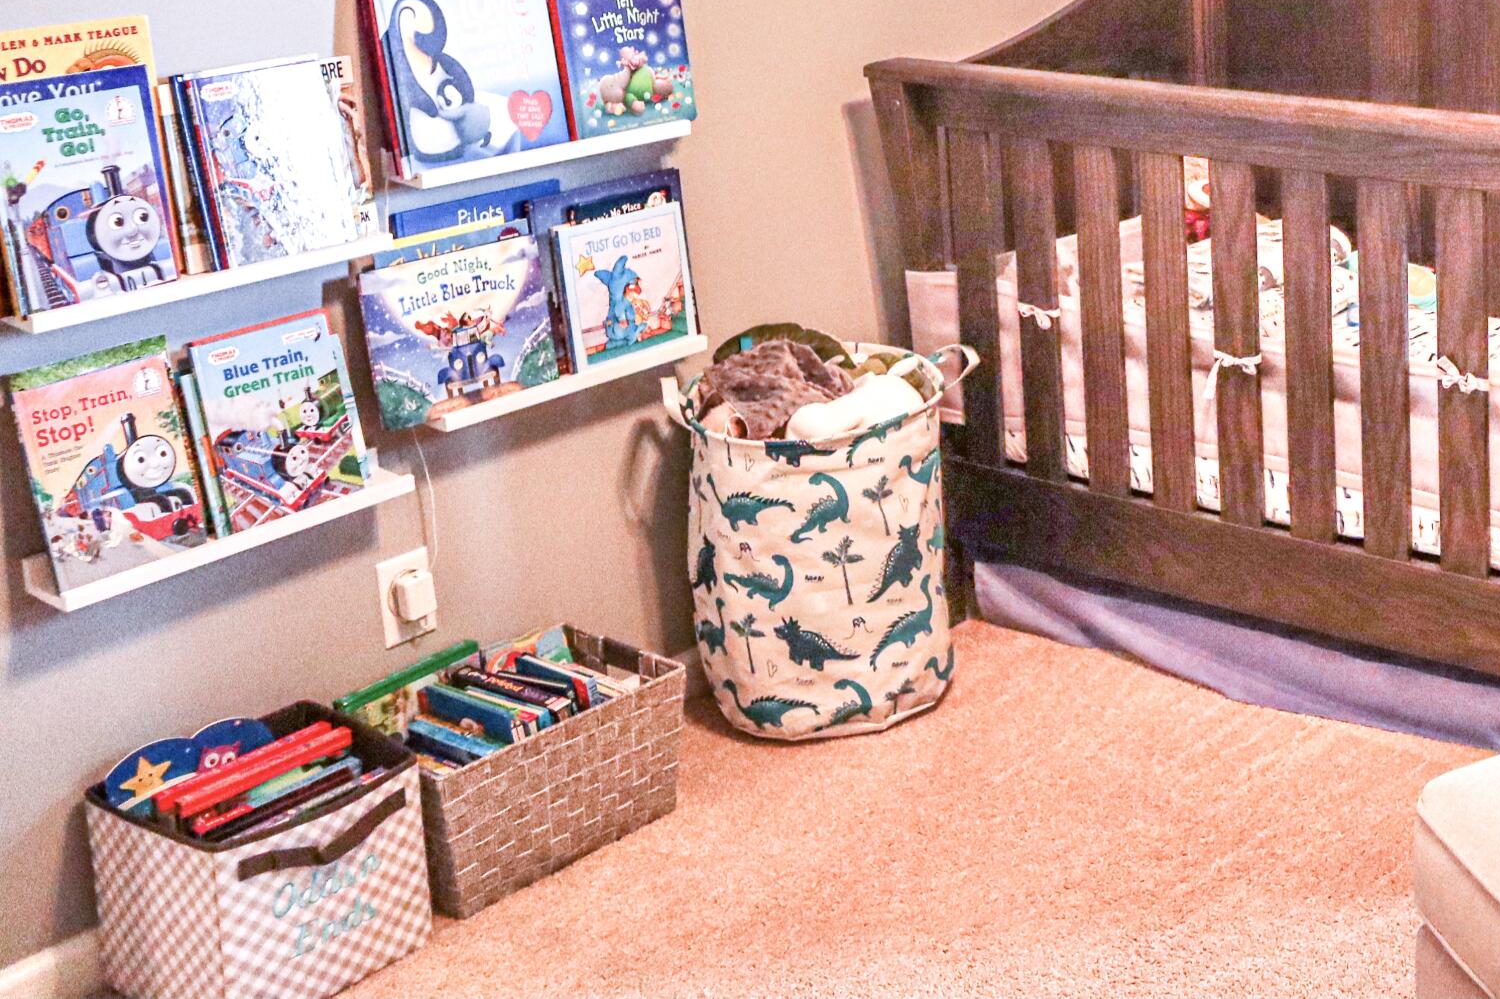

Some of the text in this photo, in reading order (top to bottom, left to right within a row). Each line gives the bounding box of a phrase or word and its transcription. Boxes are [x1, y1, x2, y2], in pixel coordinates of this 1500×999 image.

[591, 7, 661, 33] Little Night
[44, 33, 82, 46] MARK
[88, 26, 138, 41] TEAGUE
[613, 27, 645, 44] Stars
[13, 57, 47, 78] Do
[320, 61, 344, 82] ARE
[54, 107, 90, 124] Go,
[41, 122, 106, 143] Train,
[59, 138, 96, 158] Go!
[457, 204, 504, 226] Pilots
[621, 202, 642, 214] Place
[585, 226, 662, 257] JUST GO TO BED
[416, 257, 493, 285] Good Night,
[398, 274, 516, 316] Little Blue Truck
[223, 363, 259, 382] Blue
[261, 348, 309, 371] Train,
[223, 364, 316, 399] Green Train
[31, 389, 134, 425] Stop, Train,
[36, 415, 95, 448] Stop!
